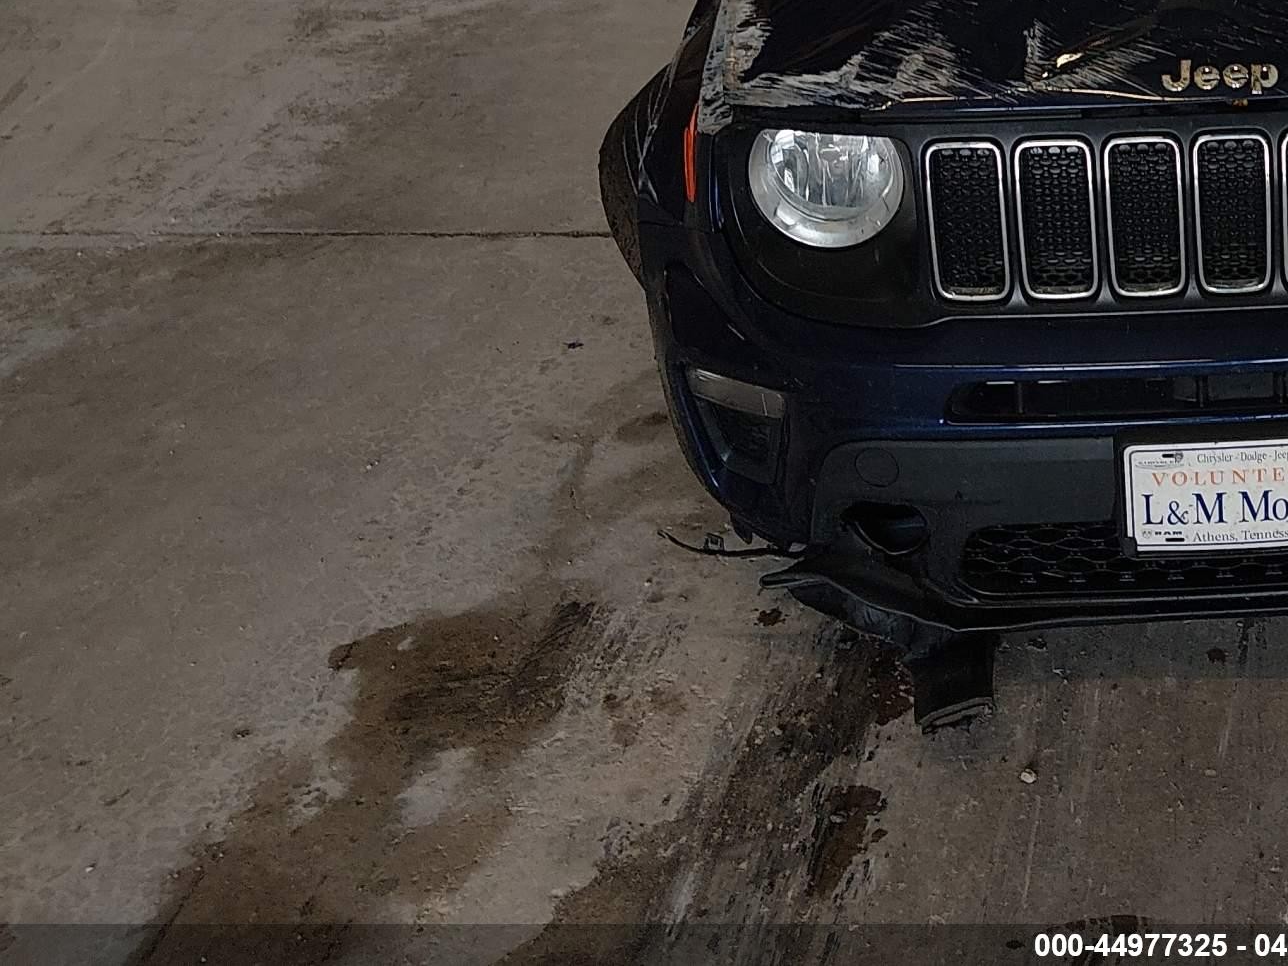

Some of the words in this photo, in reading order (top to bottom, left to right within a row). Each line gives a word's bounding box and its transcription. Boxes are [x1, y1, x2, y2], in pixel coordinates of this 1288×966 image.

[1161, 59, 1279, 95] Jeep
[1196, 452, 1234, 465] Chrysler
[1240, 451, 1267, 464] Dodge
[1141, 492, 1228, 526] L&M
[1193, 531, 1238, 543] Athens,
